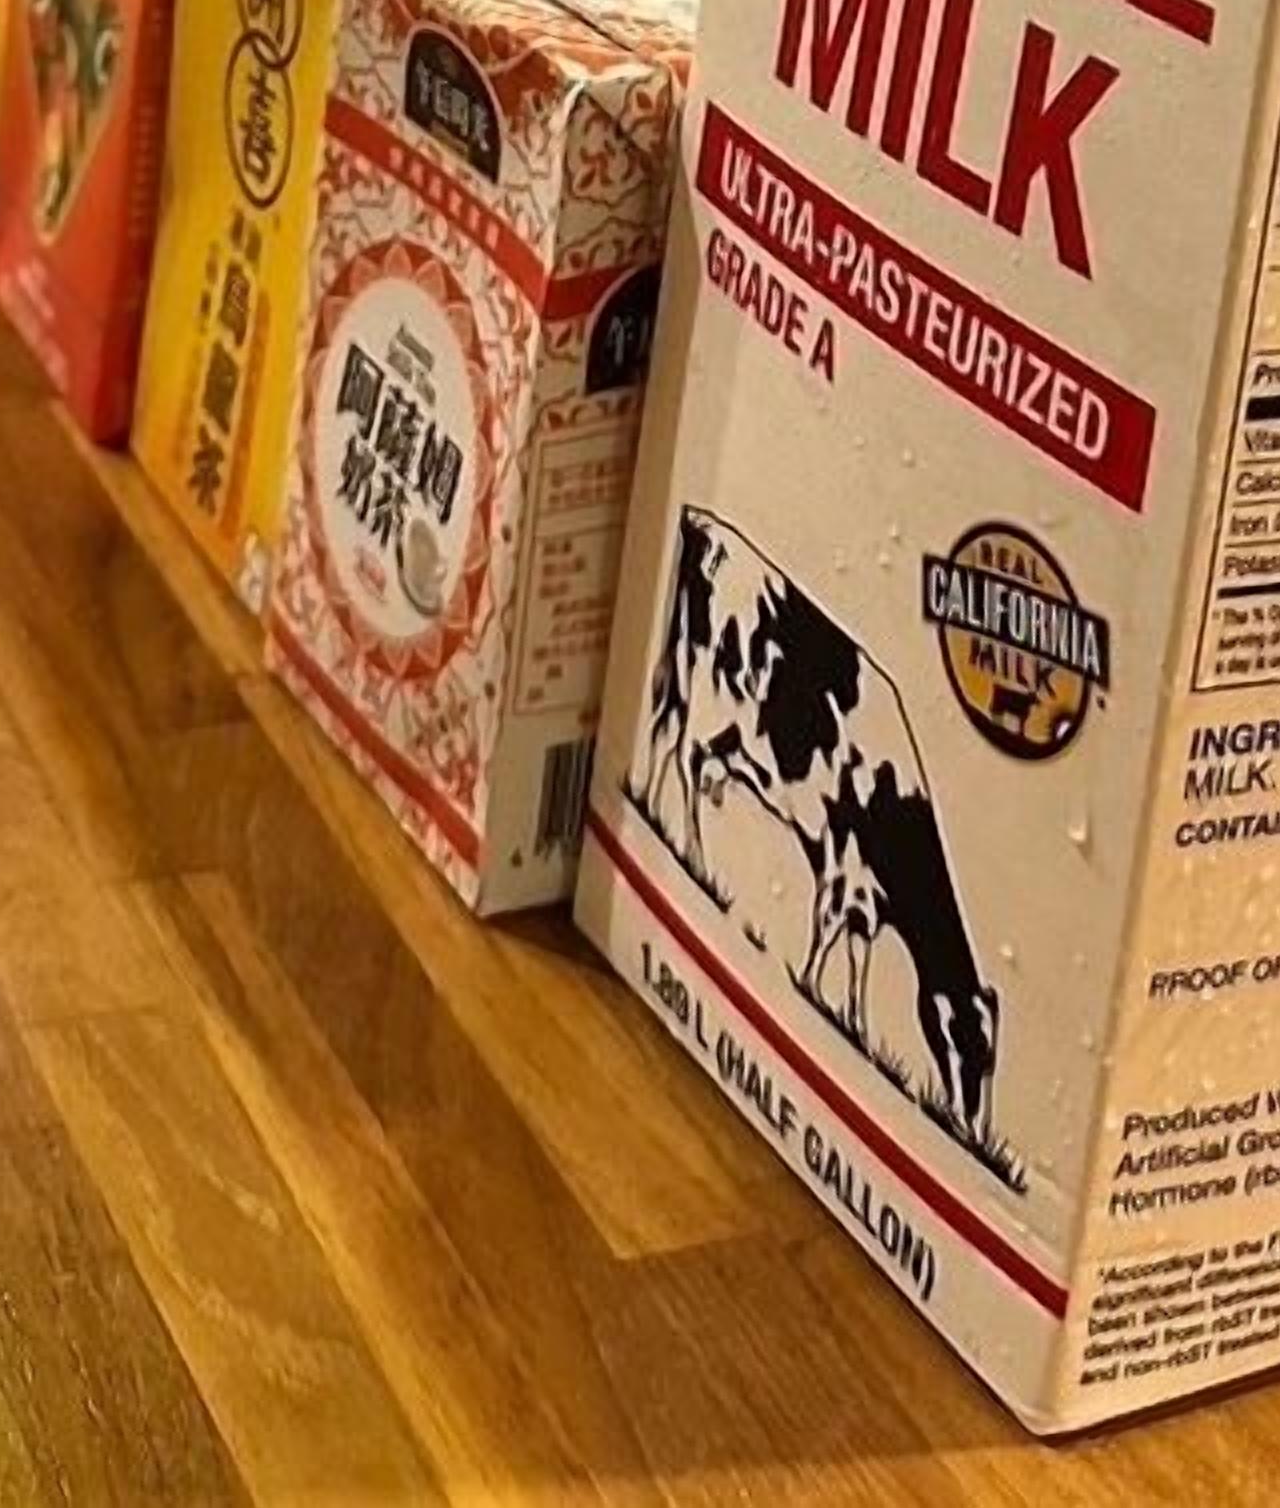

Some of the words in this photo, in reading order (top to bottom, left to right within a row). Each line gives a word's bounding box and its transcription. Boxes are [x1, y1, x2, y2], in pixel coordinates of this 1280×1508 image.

[706, 228, 808, 355] GRADE
[809, 318, 836, 384] A
[720, 139, 1111, 460] ULTRA-PASTEURIZED
[336, 343, 464, 525] 阿薩姆
[336, 434, 410, 547] 奶茶
[931, 566, 1100, 676] CALIFORNIA
[969, 639, 1056, 700] MILK
[1184, 758, 1276, 804] MILK.
[1150, 959, 1249, 999] PROOF
[1114, 1136, 1231, 1180] Artificial
[1122, 1092, 1260, 1141] Produced
[717, 1030, 798, 1138] (HALF
[804, 1125, 936, 1301] GALLON)
[1109, 1175, 1237, 1217] Hormone
